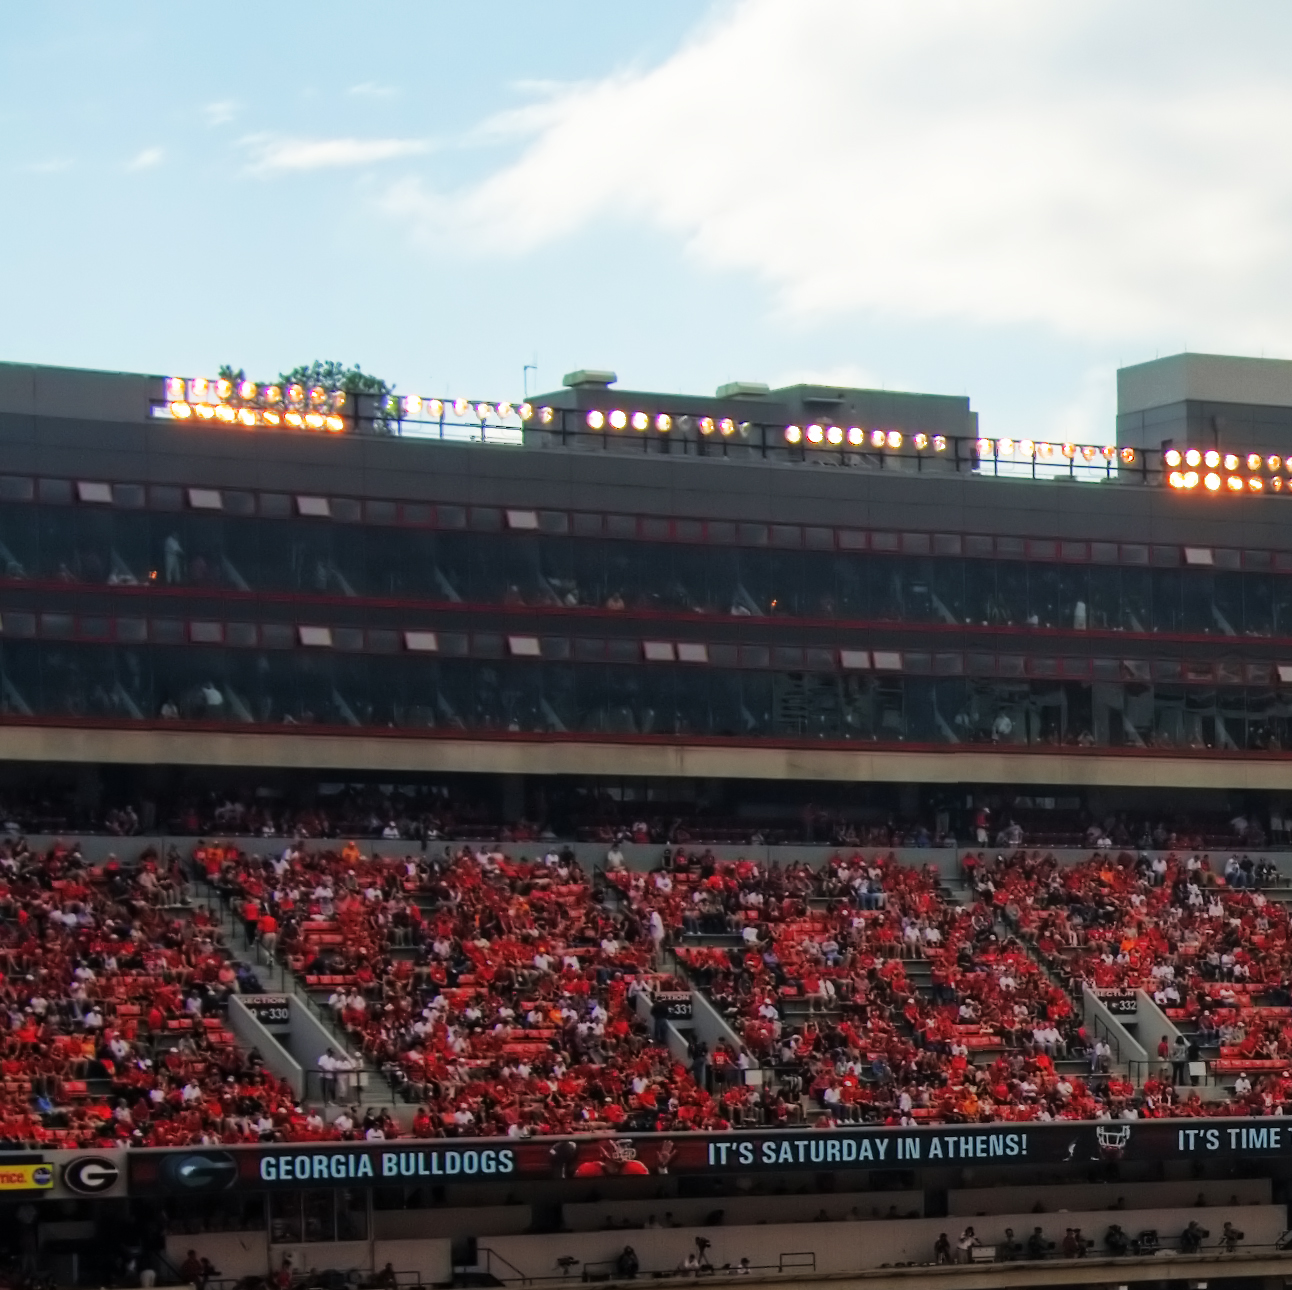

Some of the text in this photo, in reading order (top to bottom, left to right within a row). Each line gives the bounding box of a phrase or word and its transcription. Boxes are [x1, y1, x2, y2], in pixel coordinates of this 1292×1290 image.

[268, 1008, 289, 1020] 330
[674, 1003, 692, 1014] 331
[1119, 1000, 1137, 1010] 332
[1178, 1128, 1220, 1151] IT'S
[1227, 1127, 1281, 1149] TIME
[708, 1133, 1028, 1165] IT'S SATURDAY IN ATHENS!
[260, 1149, 514, 1181] GEORGIA BULLDOGS
